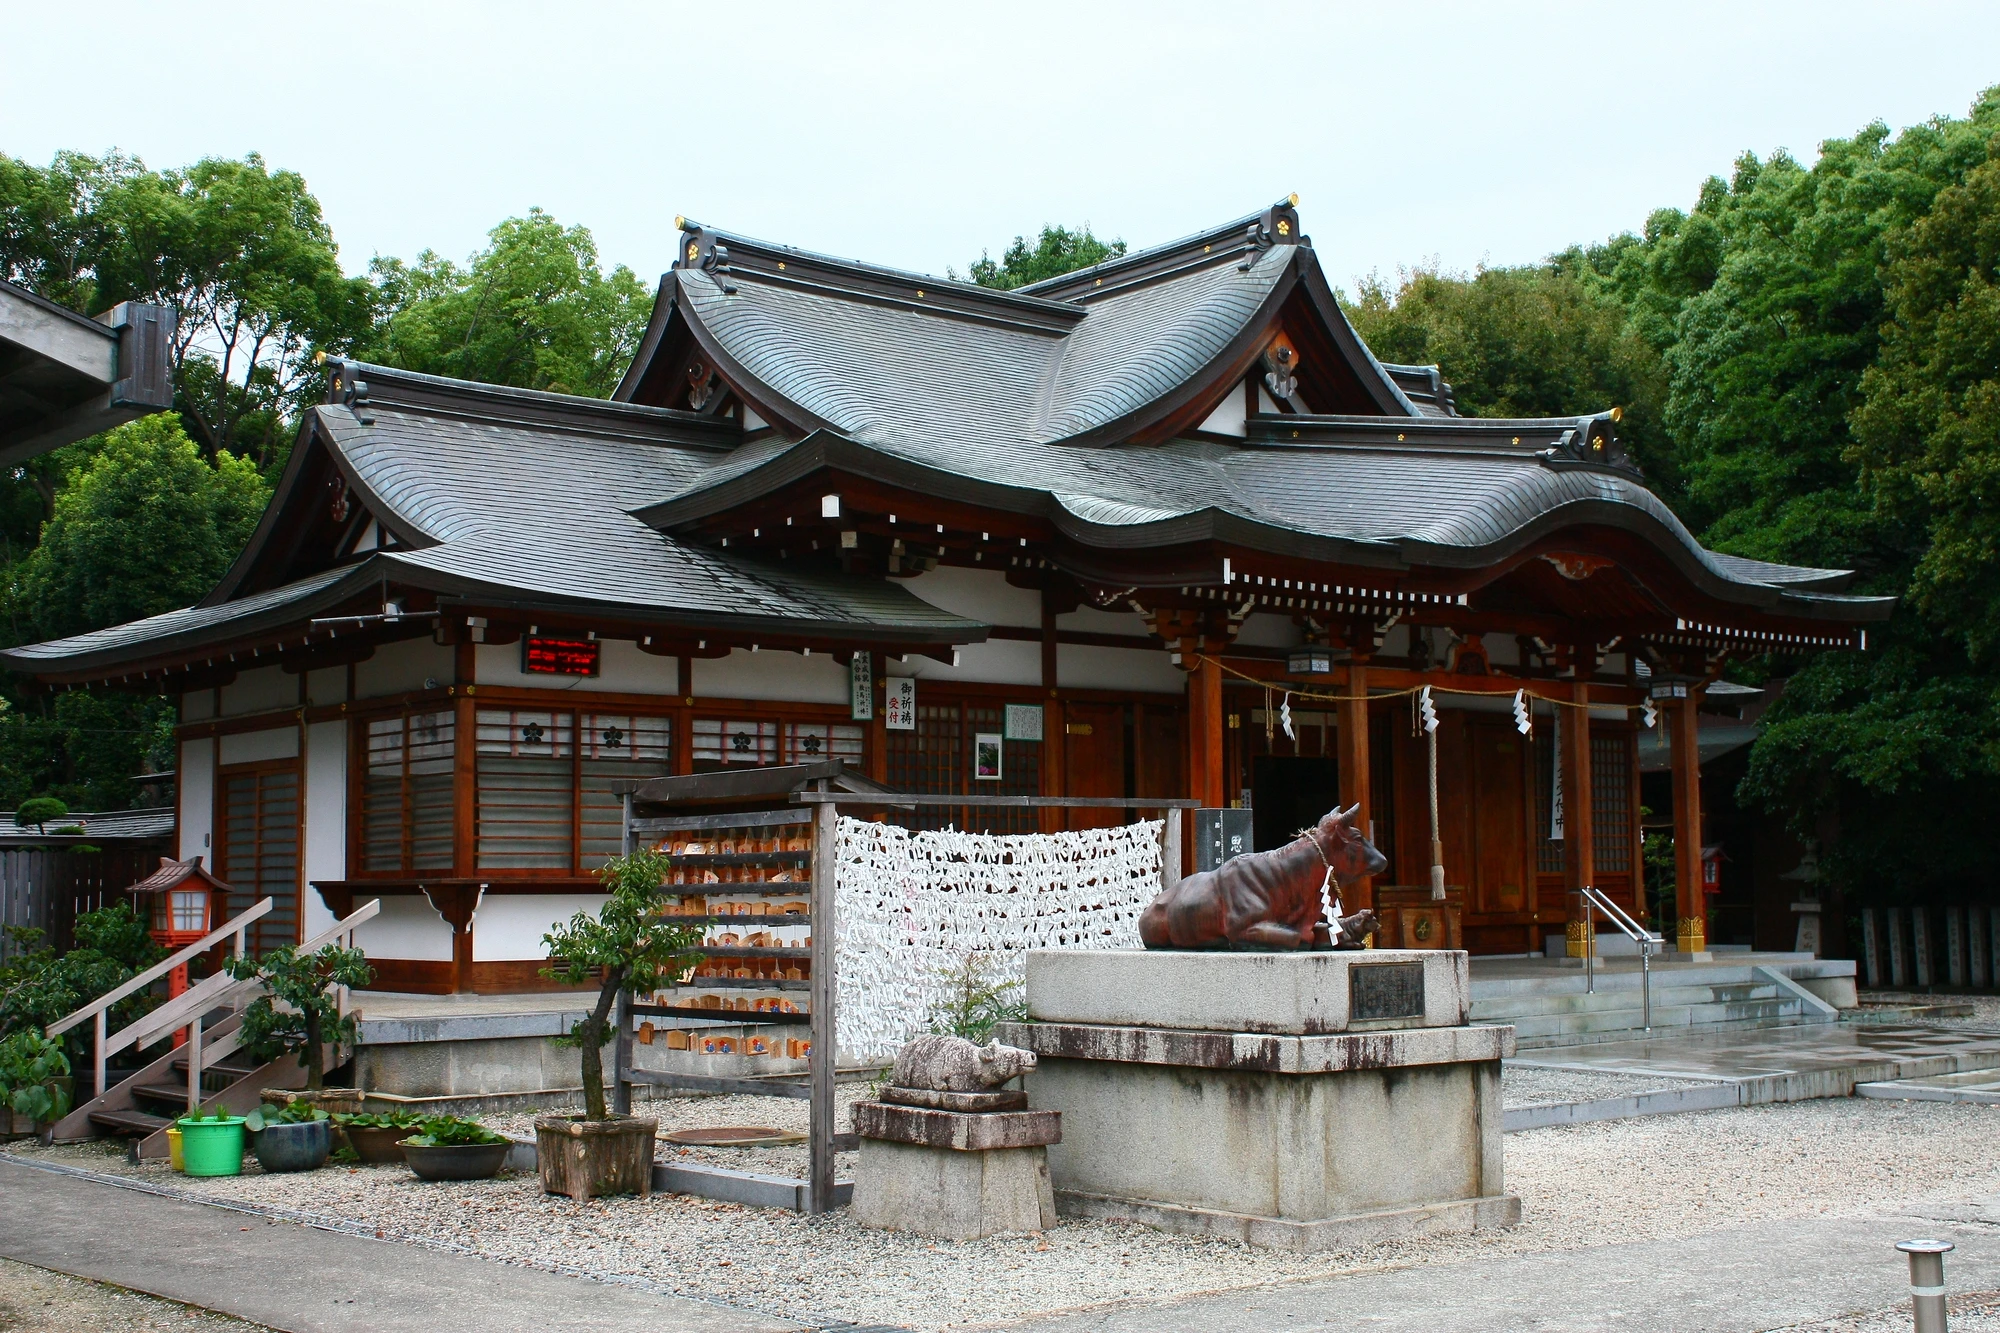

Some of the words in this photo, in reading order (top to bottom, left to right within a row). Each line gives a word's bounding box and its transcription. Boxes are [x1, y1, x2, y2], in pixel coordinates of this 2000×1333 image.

[888, 697, 899, 724] 受付
[900, 682, 912, 725] 御祈祷
